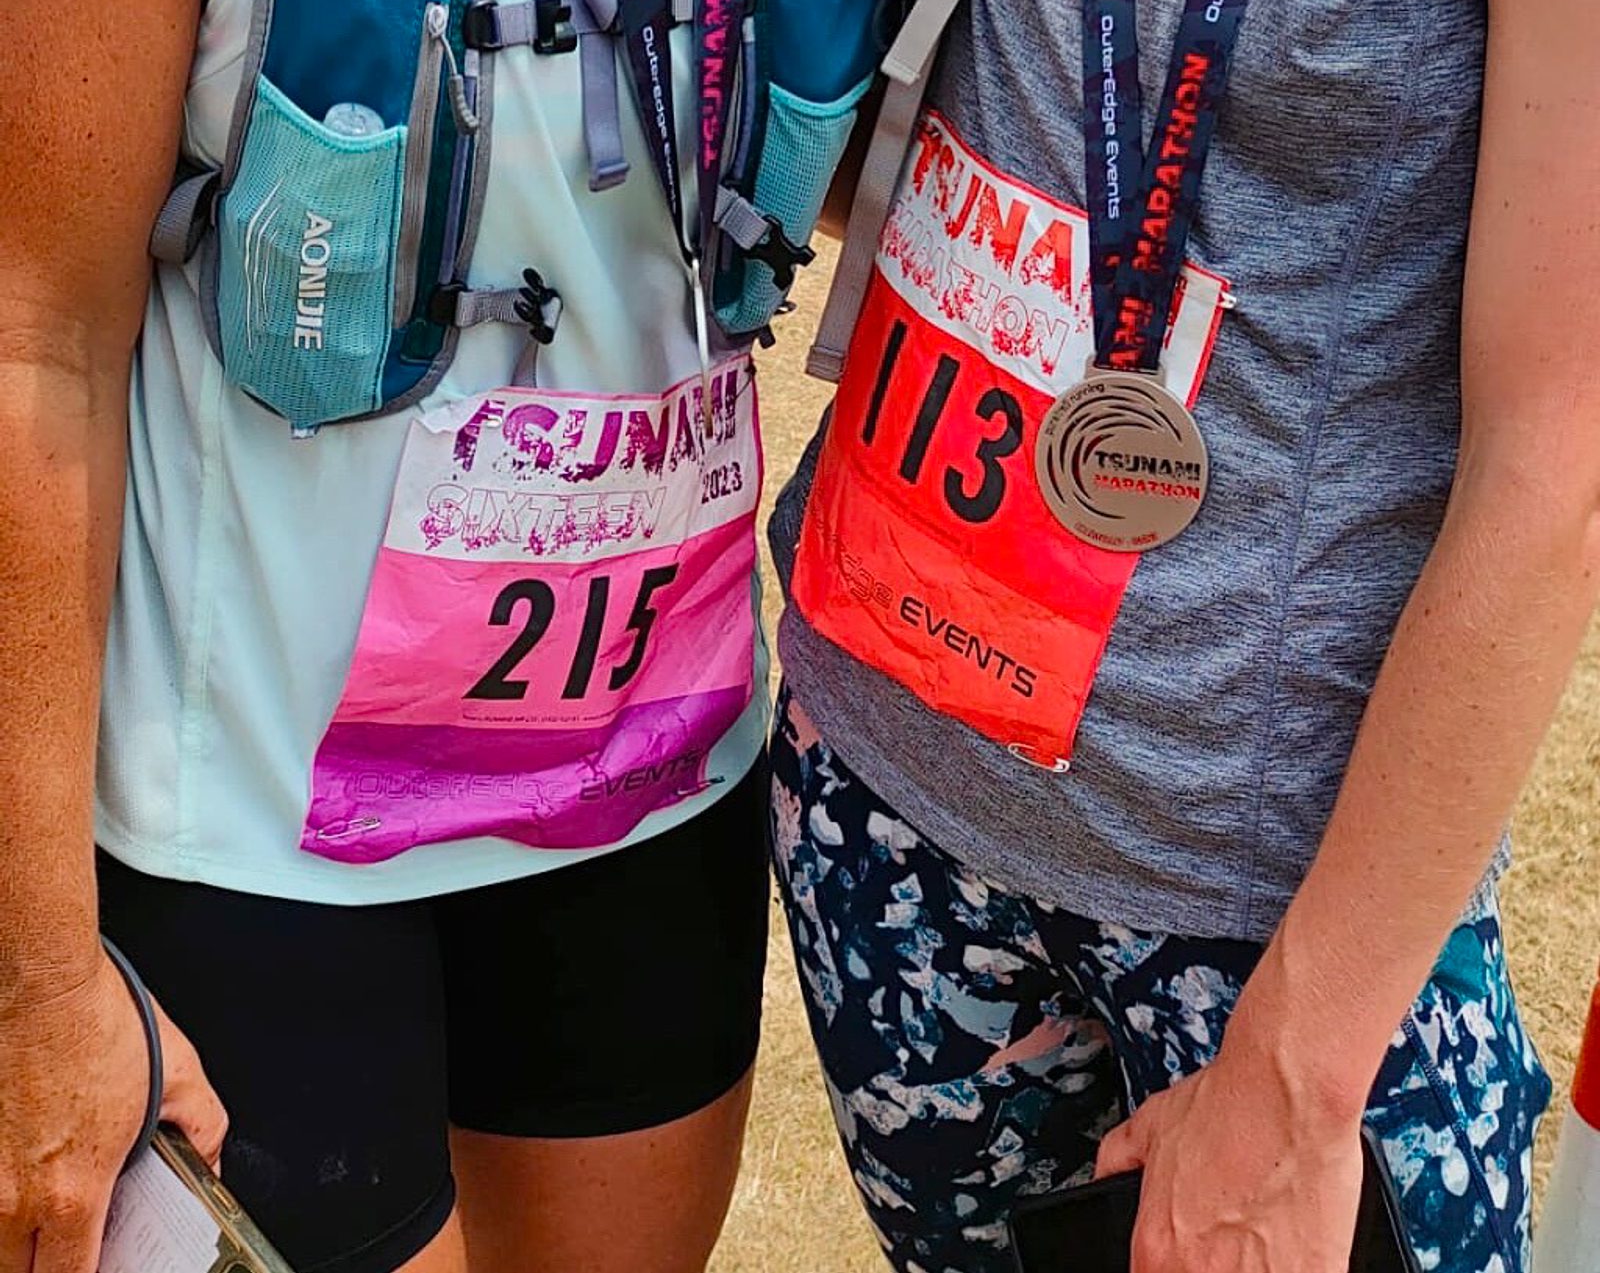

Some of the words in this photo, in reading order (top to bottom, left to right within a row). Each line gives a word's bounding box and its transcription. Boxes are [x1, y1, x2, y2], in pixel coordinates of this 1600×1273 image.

[1101, 14, 1118, 136] OuterEdge
[1105, 139, 1120, 220] Events
[294, 210, 333, 351] AONIJIE
[861, 319, 1025, 524] 113
[1094, 450, 1201, 483] TSUNAMI
[419, 483, 669, 556] SIXTEEN
[1093, 473, 1201, 501] MARATHON
[462, 564, 679, 701] 215
[899, 595, 1038, 698] EVENTS
[578, 751, 701, 802] EVENTS
